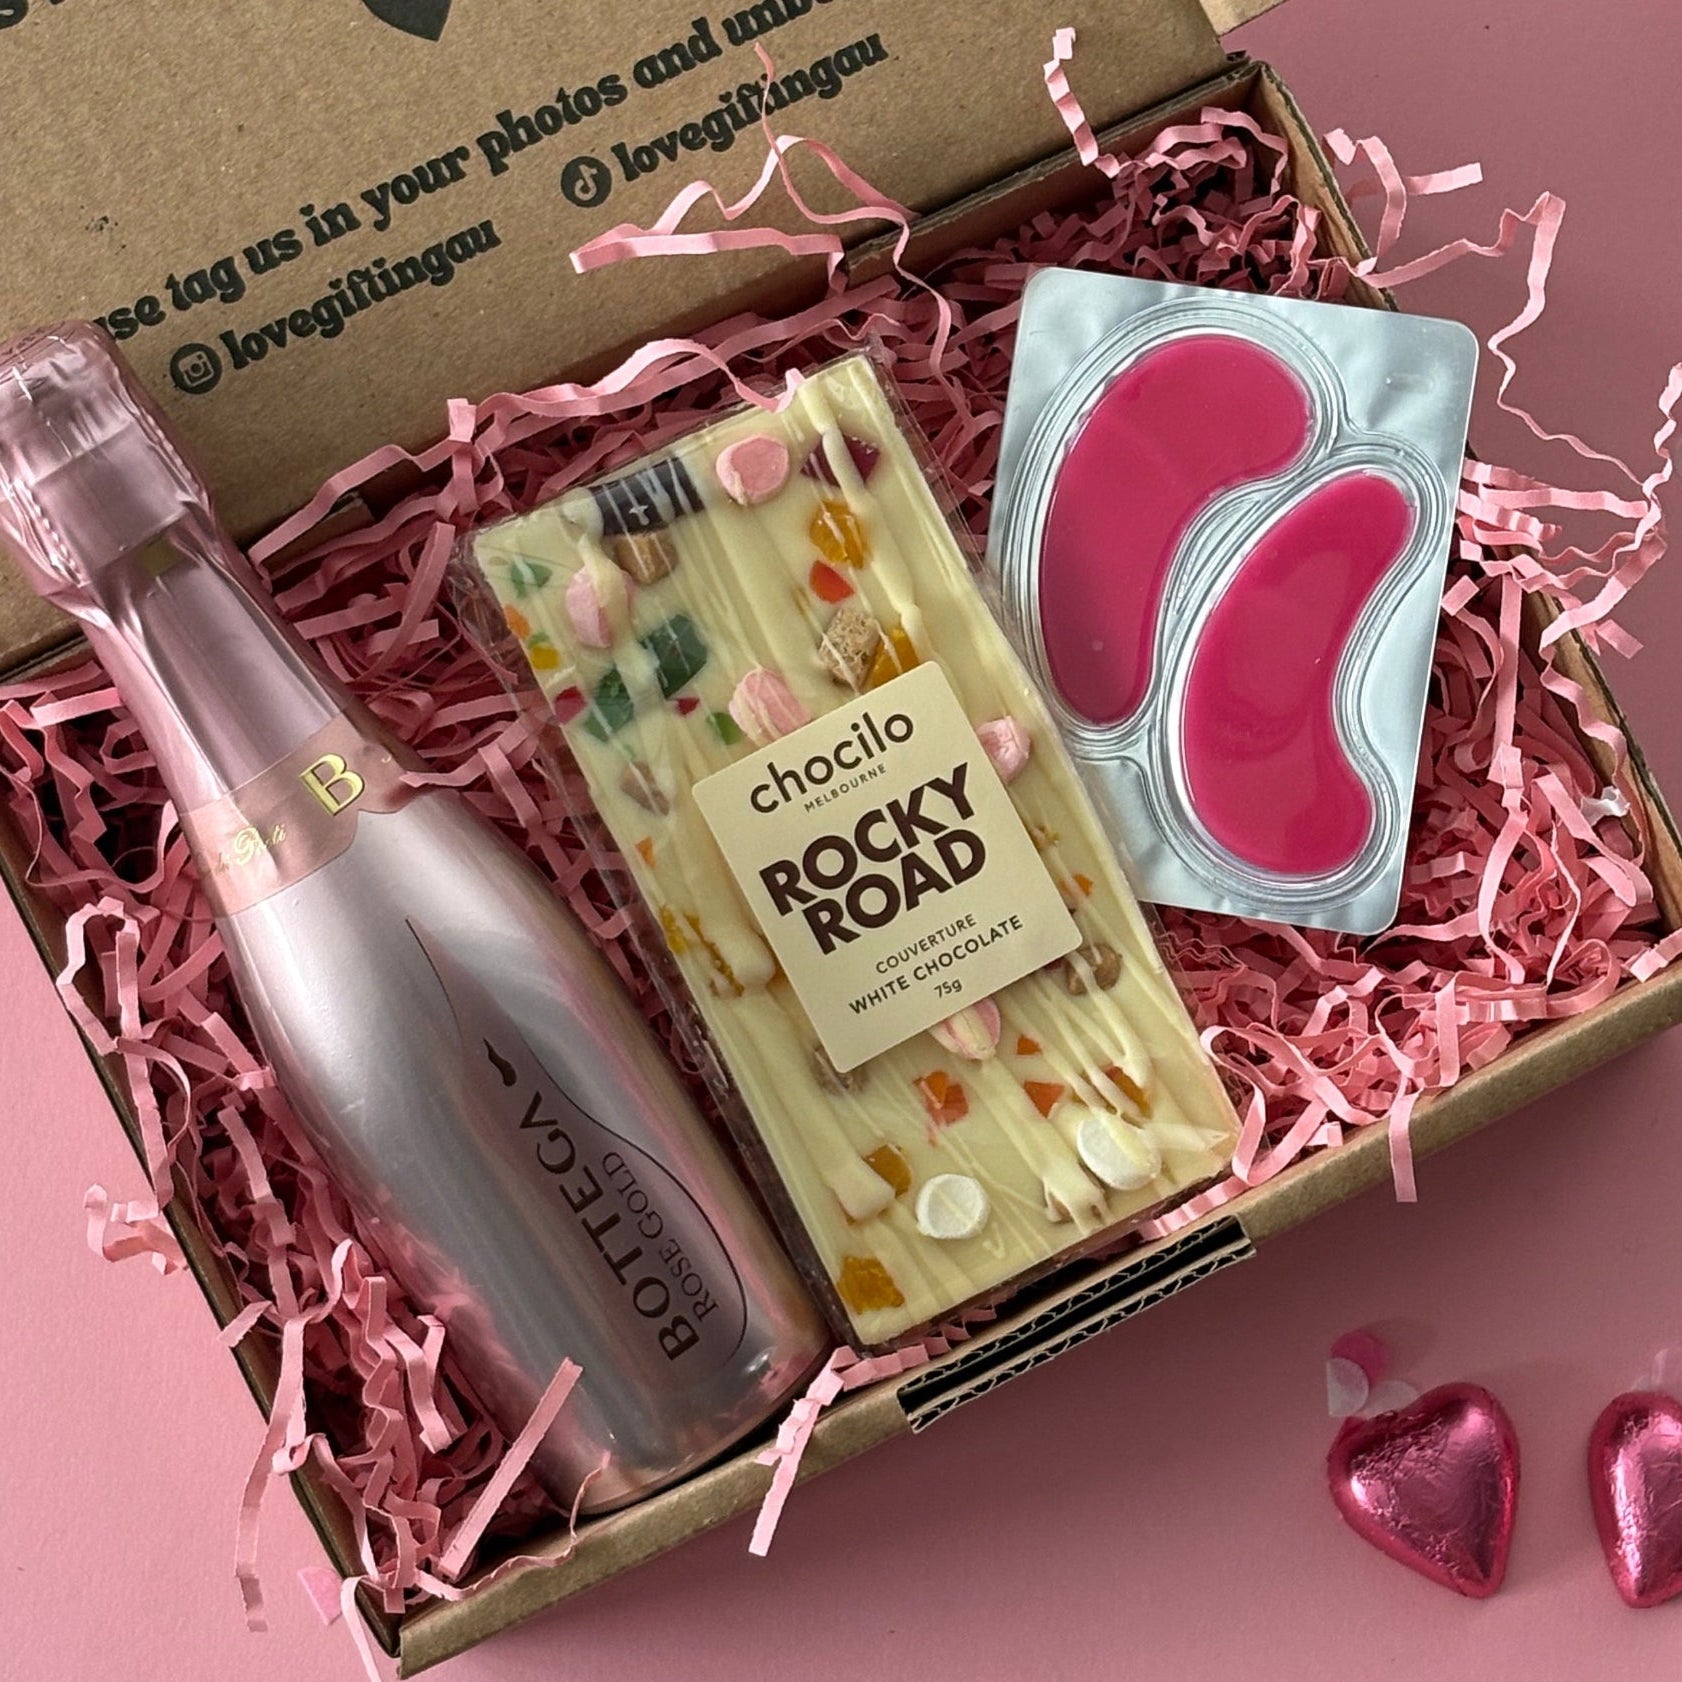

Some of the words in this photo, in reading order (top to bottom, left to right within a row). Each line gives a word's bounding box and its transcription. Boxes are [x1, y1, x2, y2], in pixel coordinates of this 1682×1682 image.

[611, 33, 889, 182] lovegiftingau
[165, 256, 246, 304] tag
[243, 229, 303, 274] us
[300, 203, 361, 247] in
[361, 146, 470, 231] your
[476, 74, 628, 177] photos
[633, 16, 723, 89] and
[219, 220, 502, 370] lovegiftingau
[299, 753, 365, 817] B
[750, 712, 914, 814] chocilo
[803, 764, 887, 813] MELBOURNE
[759, 762, 975, 917] ROCKY
[801, 828, 986, 956] ROAD
[848, 975, 911, 1015] WHITE
[913, 915, 1023, 982] CHOCOLATE
[875, 914, 977, 974] COUVERTURE
[934, 979, 962, 999] 75g
[519, 1090, 700, 1361] BOTTEGA
[602, 1151, 664, 1240] GOLD
[660, 1238, 719, 1323] ROSE
